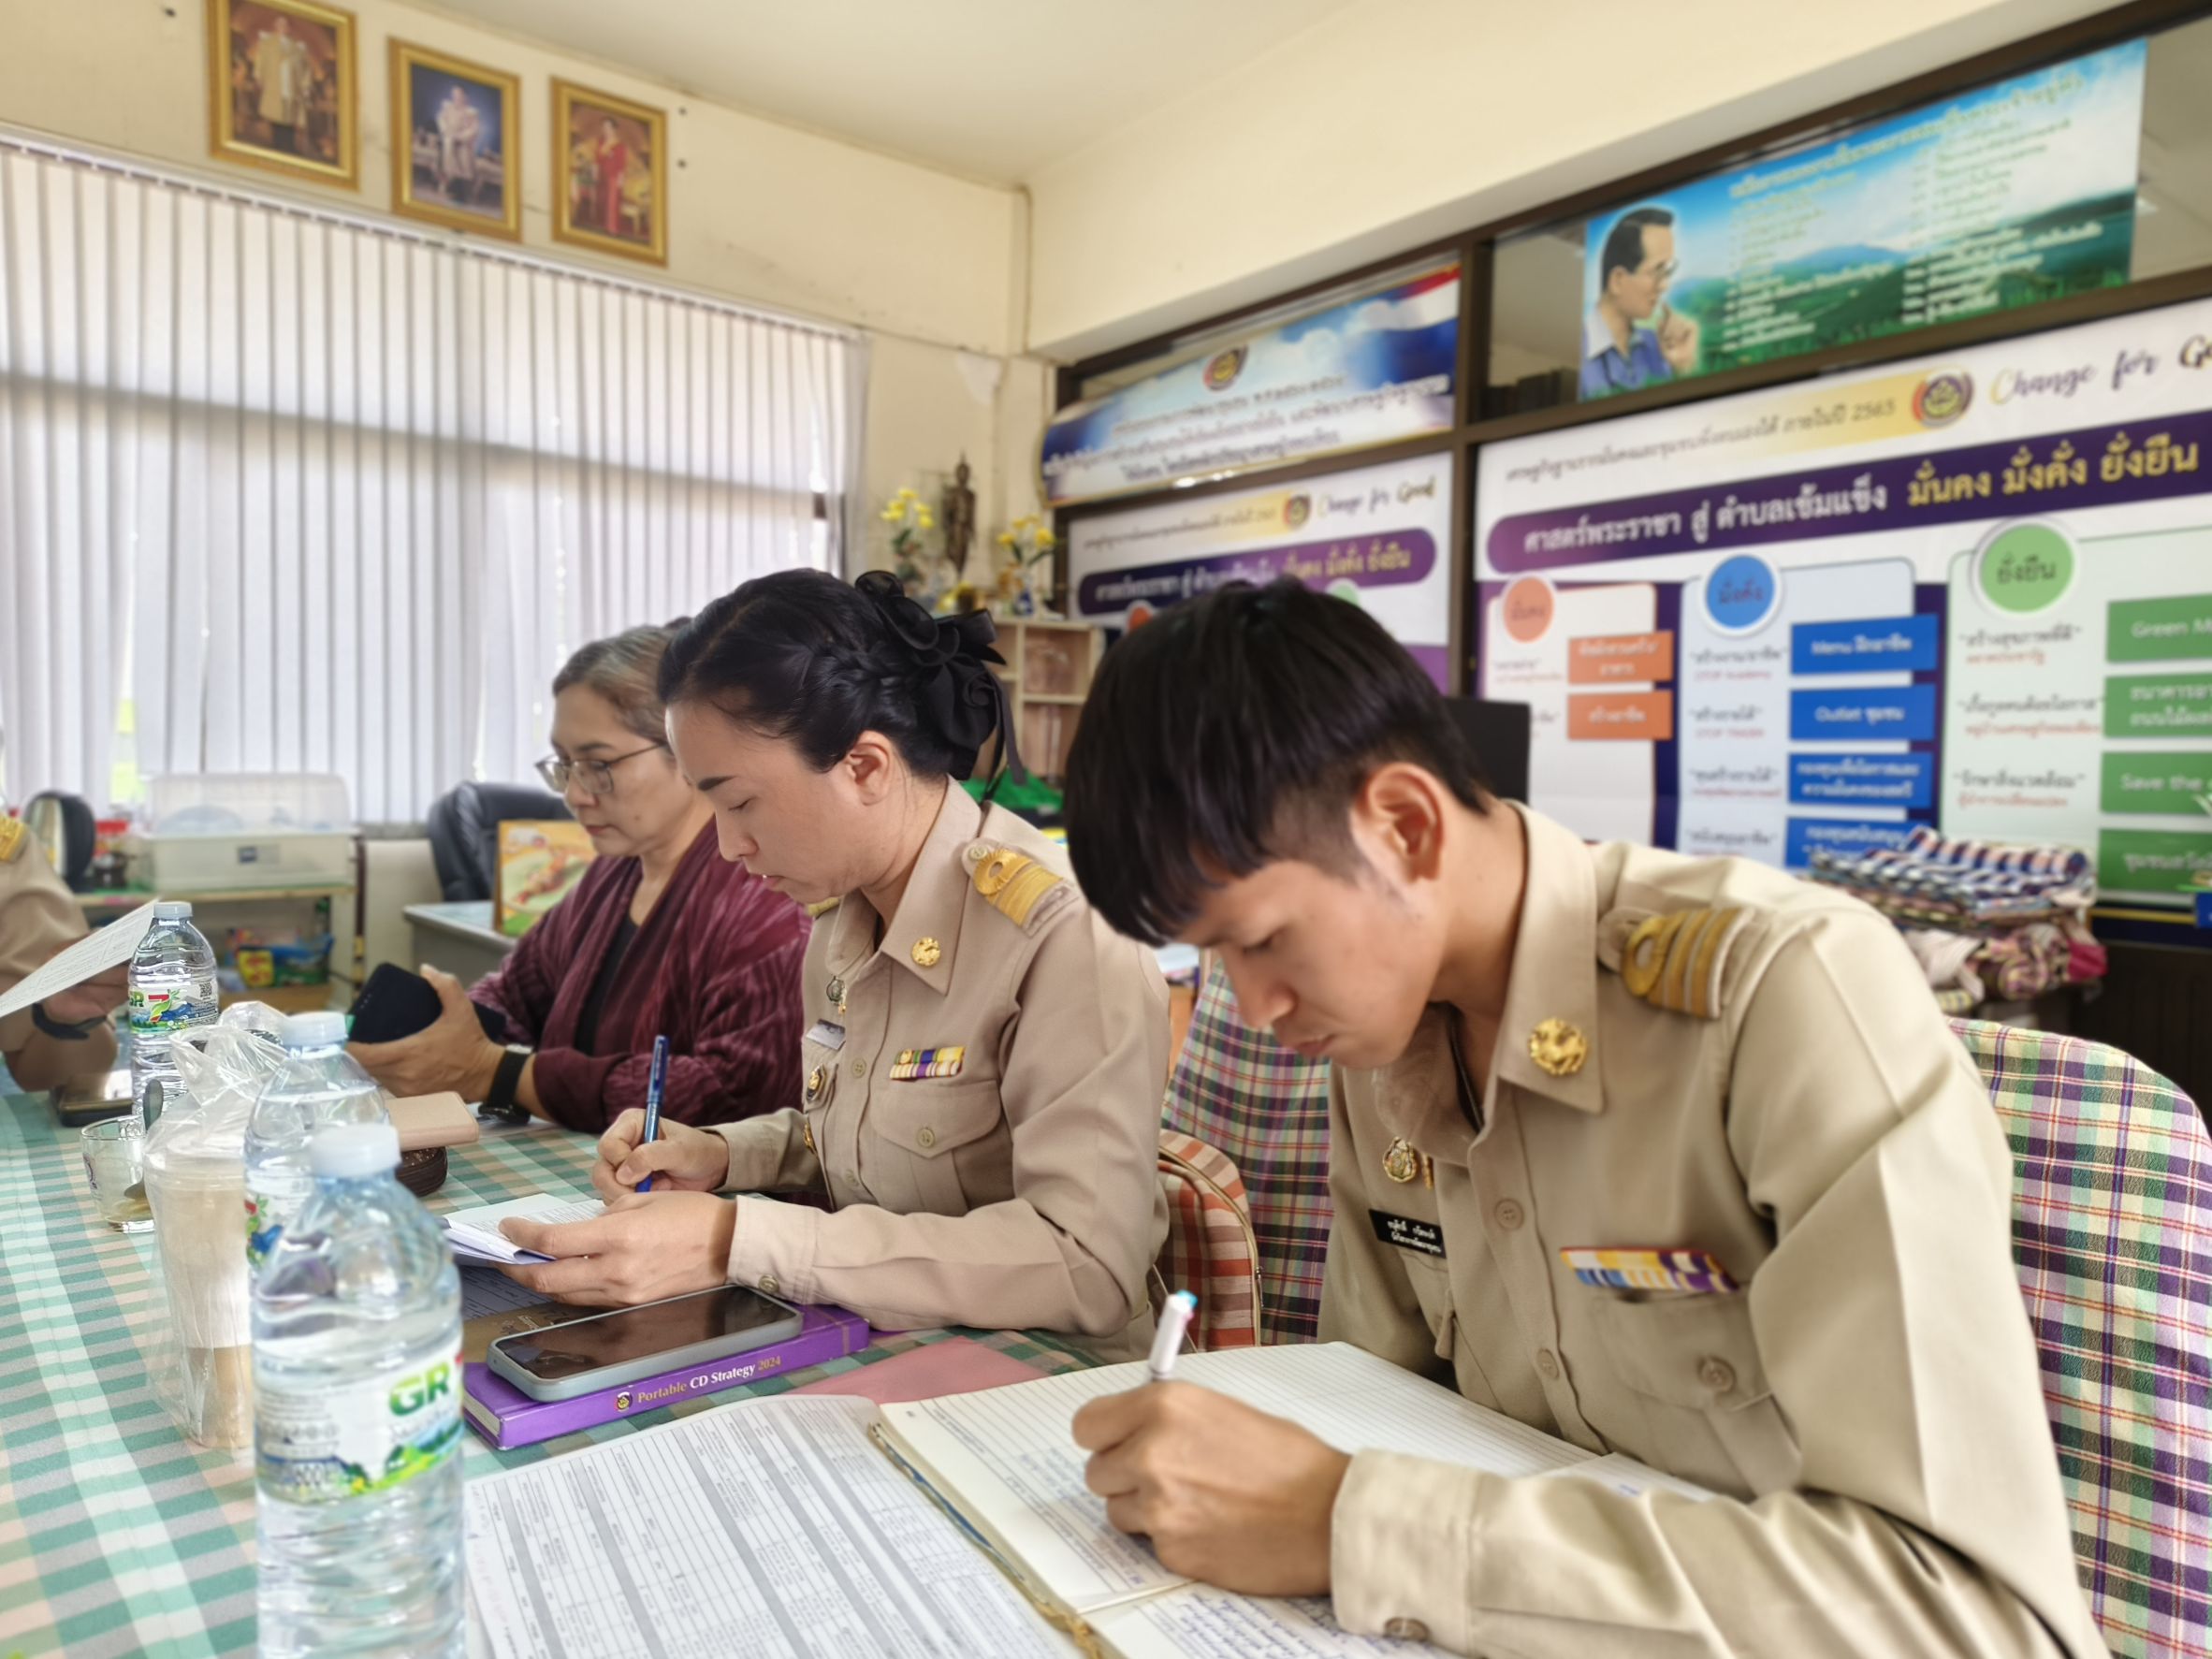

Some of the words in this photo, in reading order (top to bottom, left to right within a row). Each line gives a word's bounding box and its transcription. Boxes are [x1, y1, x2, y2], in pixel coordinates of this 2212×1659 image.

[1990, 365, 2098, 406] Change
[2111, 350, 2160, 391] for
[1524, 511, 1681, 554] ศาสตร์พระราชา
[1691, 500, 1710, 545] สู่
[1716, 473, 1888, 531] ตำบลเข้มแข็ง
[1907, 459, 1992, 507] มั่นคง
[2002, 439, 2088, 495] มั่งคั่ง
[2100, 430, 2199, 483] ยั่งยืน
[1996, 553, 2057, 585] ยั่งยืน
[2120, 773, 2165, 791] Save
[2170, 776, 2202, 792] the
[388, 1361, 450, 1417] GR
[637, 1380, 688, 1404] Portable
[690, 1371, 709, 1390] CD
[710, 1362, 757, 1386] Strategy
[758, 1356, 782, 1372] 2024
